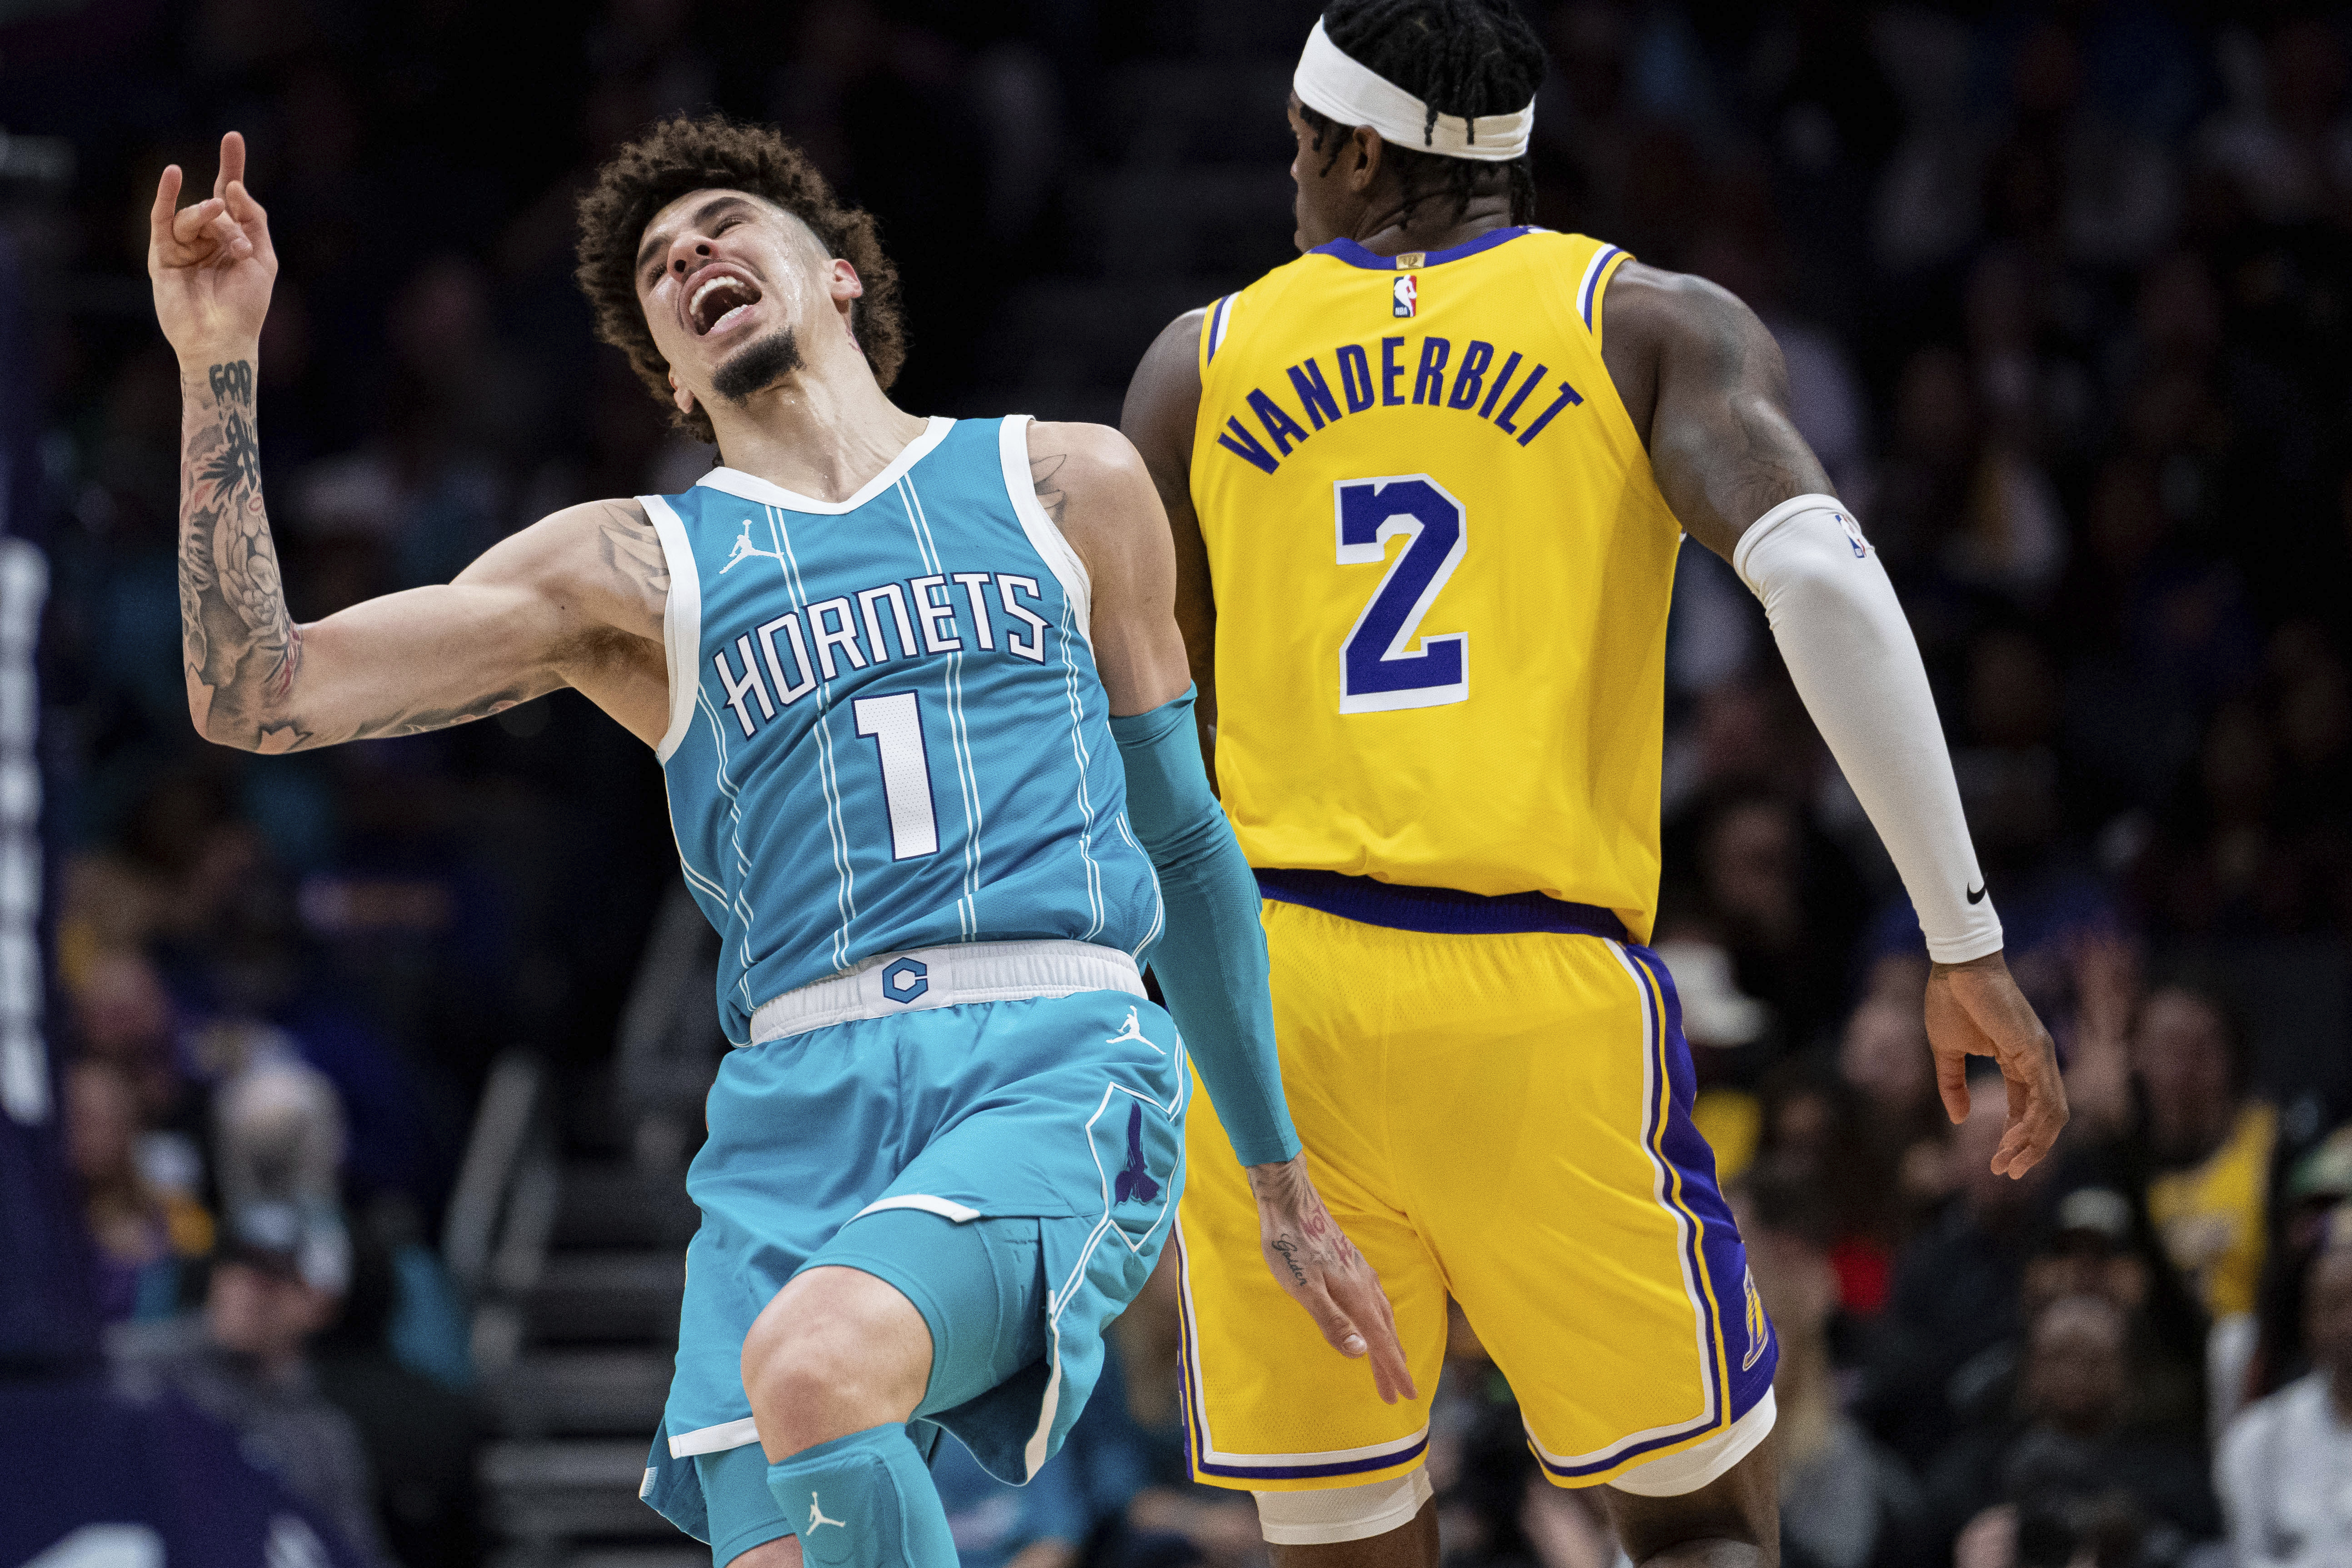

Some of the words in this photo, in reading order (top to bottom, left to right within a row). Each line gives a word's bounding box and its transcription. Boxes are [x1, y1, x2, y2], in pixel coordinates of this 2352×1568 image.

[1395, 307, 1408, 315] NBA
[209, 360, 252, 407] GOD
[1217, 336, 1584, 475] VANDERBILT
[713, 572, 1053, 741] HORNETS
[1333, 473, 1468, 714] 2
[851, 689, 939, 862] 1
[882, 957, 928, 1004] C
